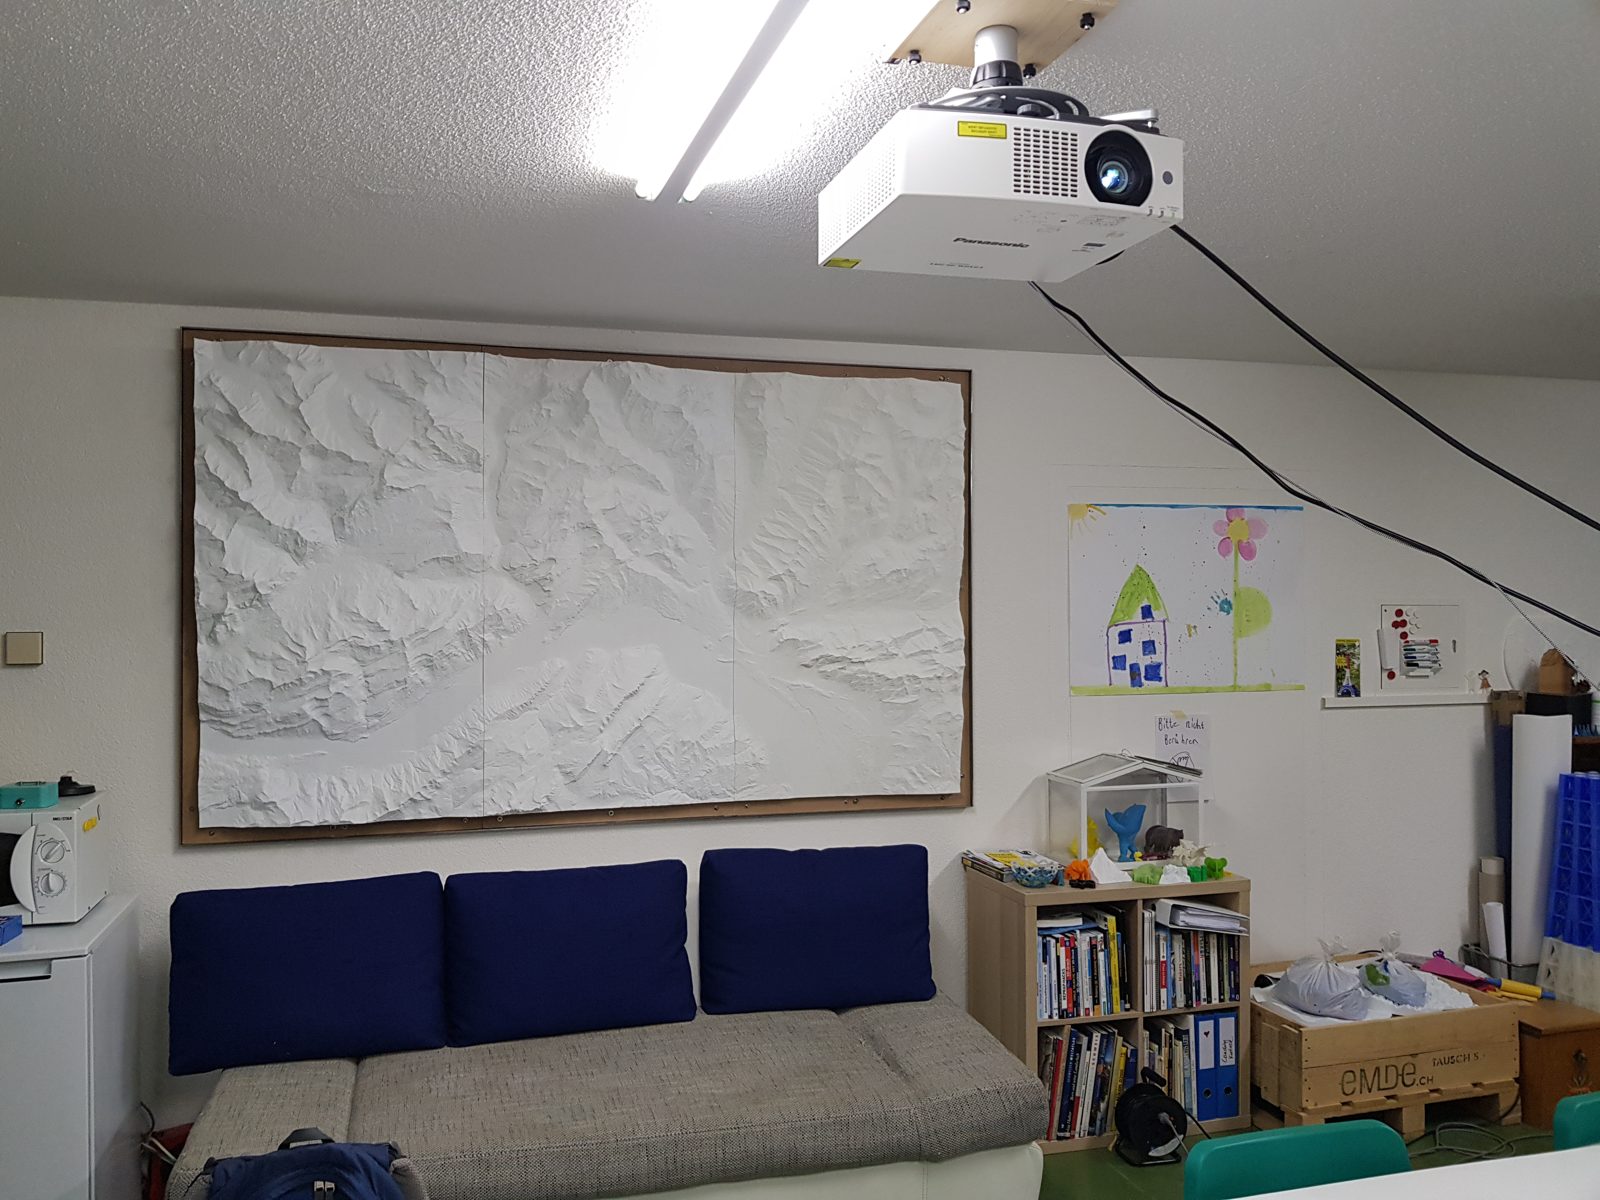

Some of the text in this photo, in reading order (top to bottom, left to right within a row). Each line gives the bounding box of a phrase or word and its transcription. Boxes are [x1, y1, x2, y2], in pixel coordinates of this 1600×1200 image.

[953, 236, 1031, 249] Panasonic
[1158, 717, 1204, 731] Bitte nicht
[1432, 1052, 1471, 1067] TAUSCH
